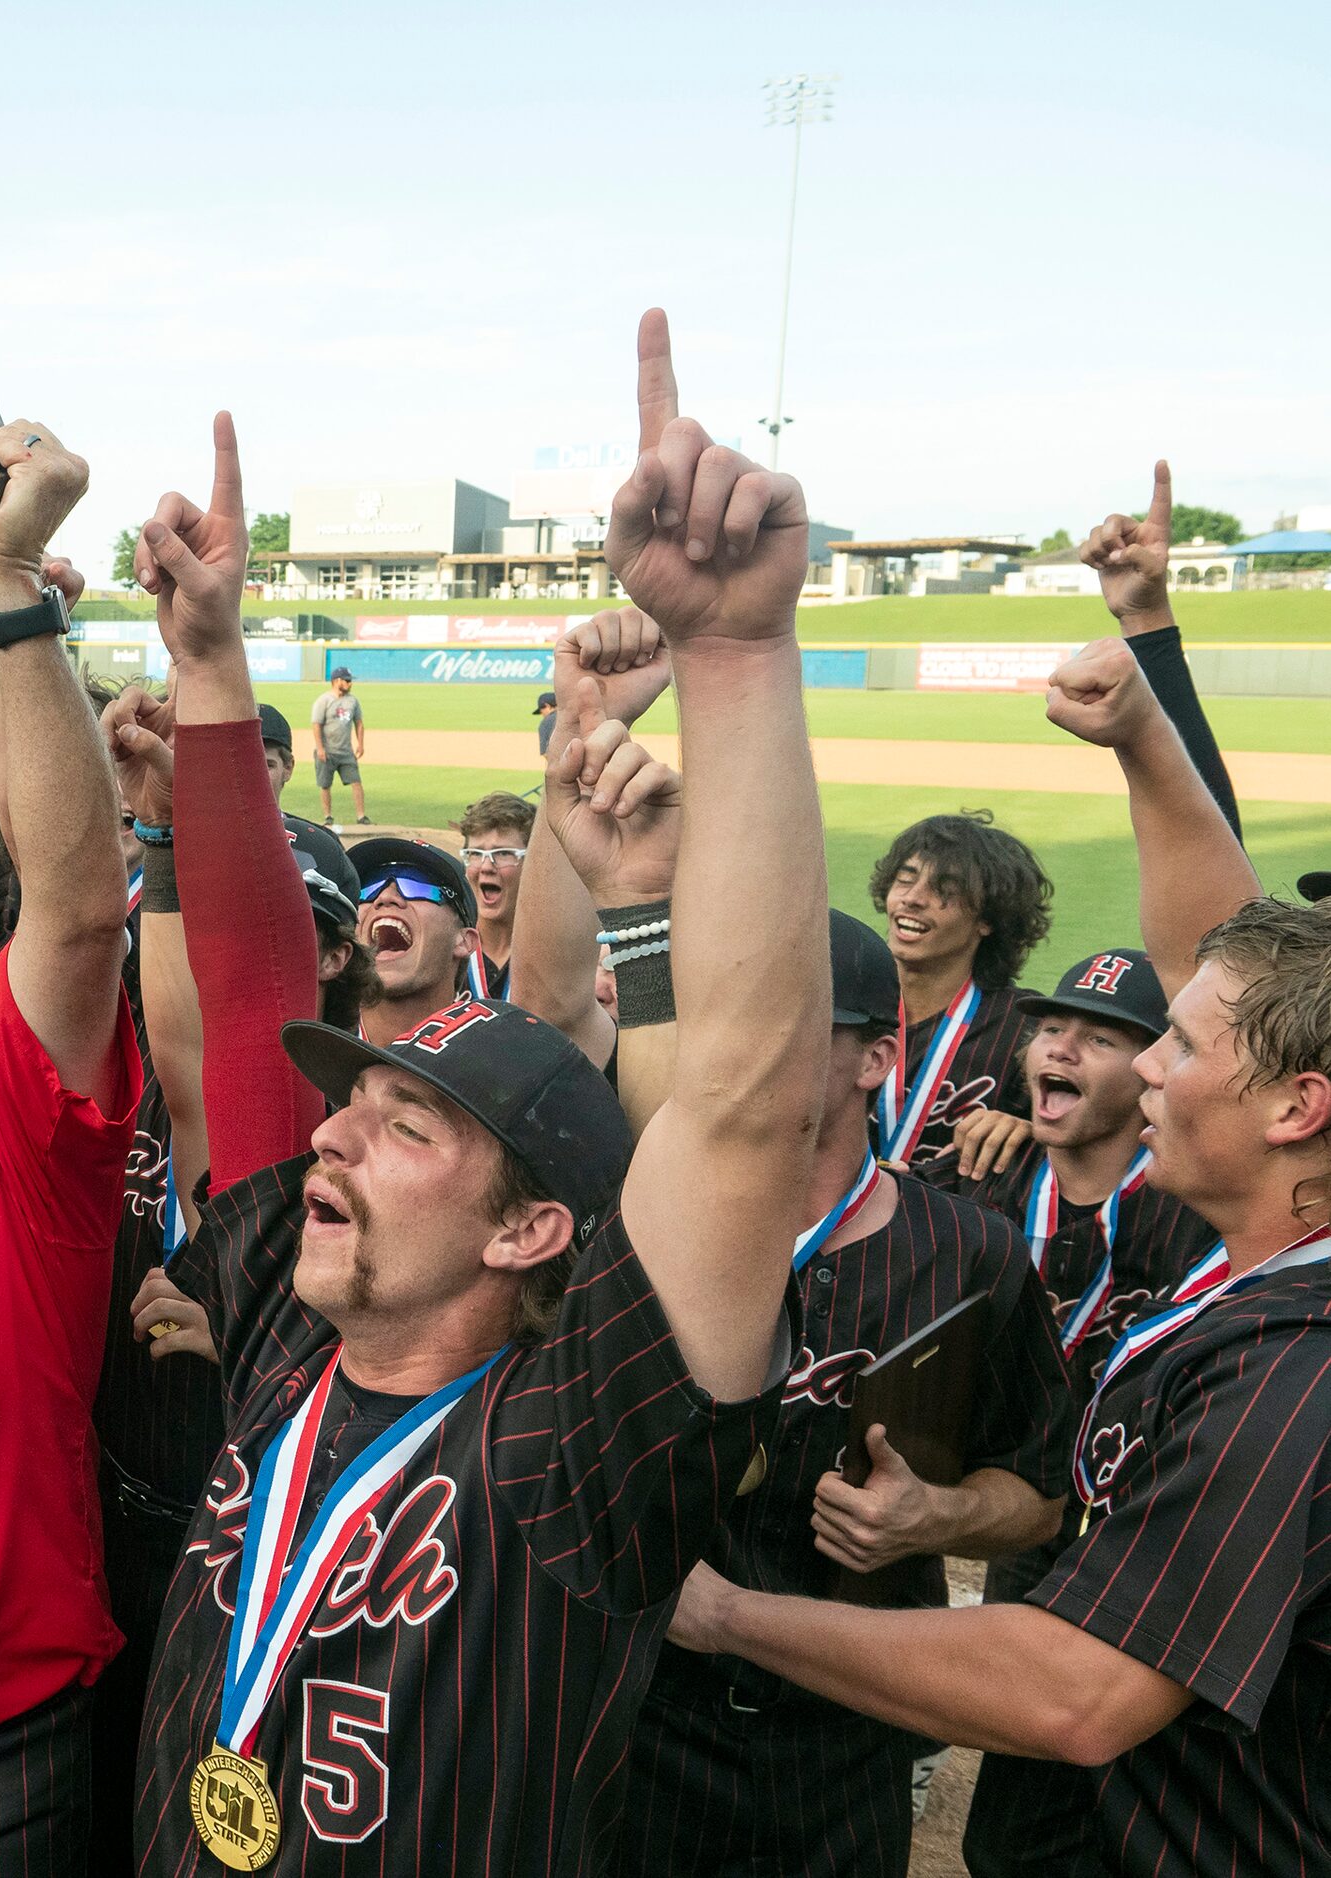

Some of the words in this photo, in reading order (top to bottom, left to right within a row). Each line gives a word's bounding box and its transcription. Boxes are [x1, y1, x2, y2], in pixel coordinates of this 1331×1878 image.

[454, 617, 560, 643] Budweiser
[421, 651, 543, 682] Welcome
[1075, 953, 1134, 995] H
[391, 1000, 499, 1055] H
[301, 1678, 391, 1844] 5
[190, 1768, 212, 1843] UNIVERSITY
[204, 1756, 277, 1823] INTERSCHOLASTIC
[205, 1775, 260, 1843] UIL
[212, 1822, 248, 1851] STATE
[250, 1828, 277, 1869] LEAGUE
